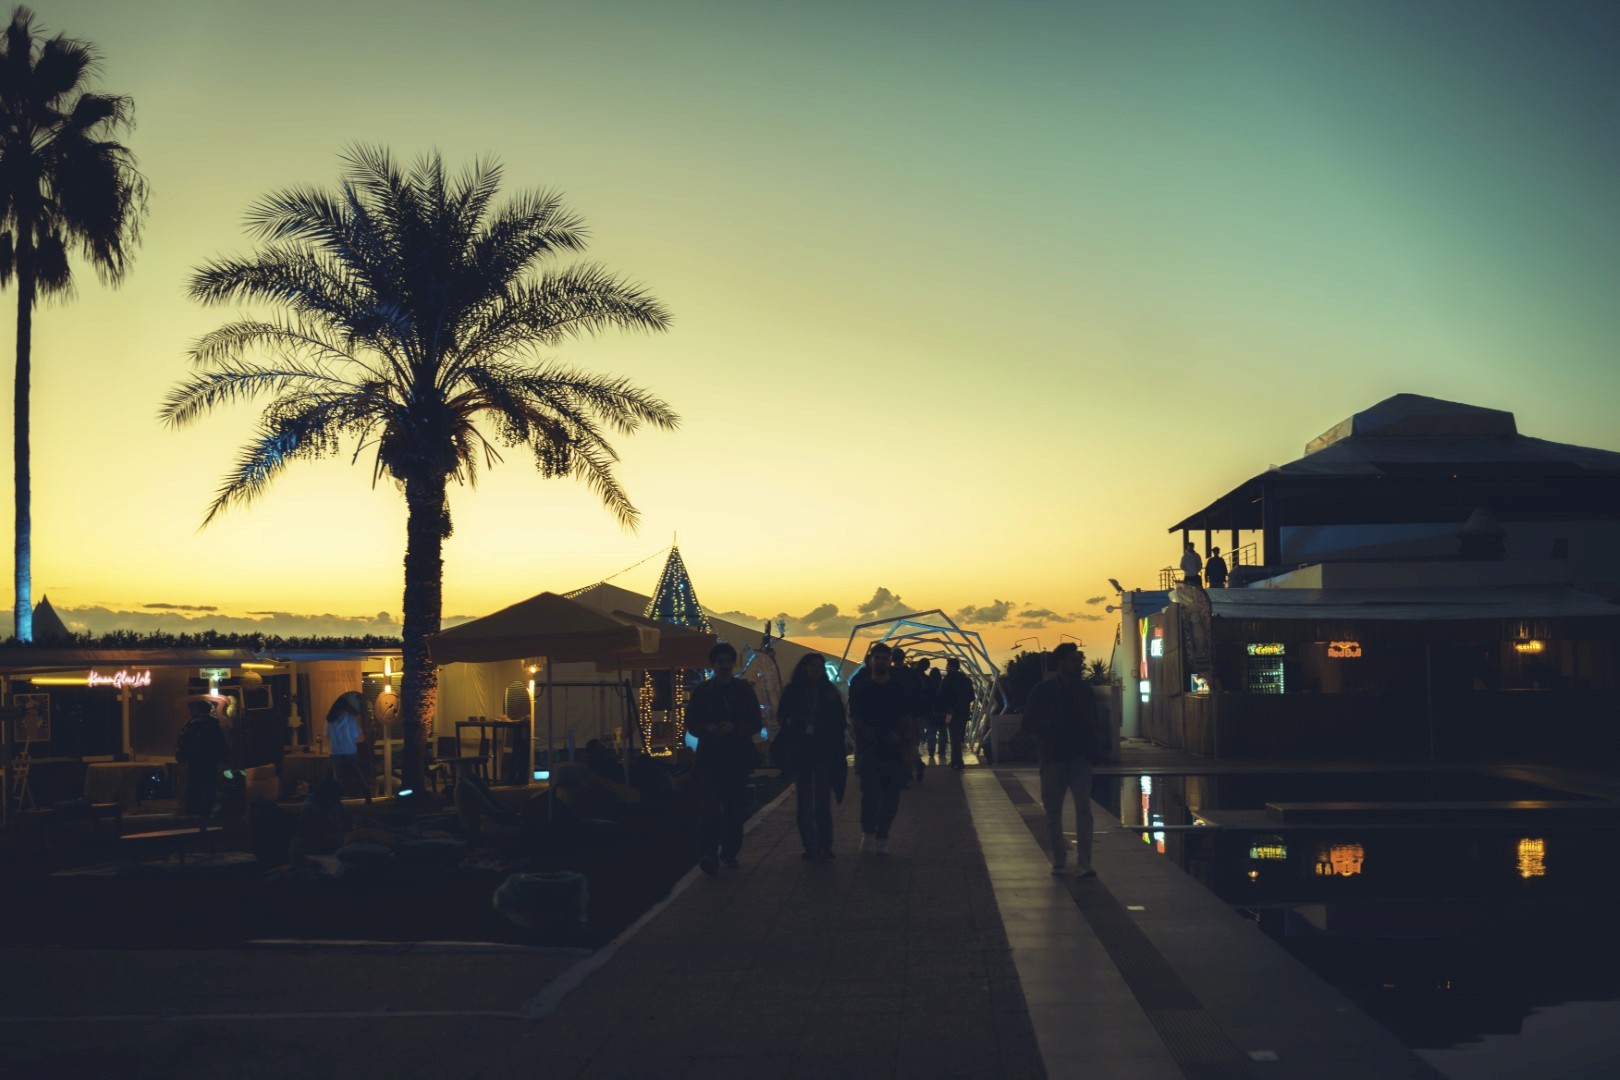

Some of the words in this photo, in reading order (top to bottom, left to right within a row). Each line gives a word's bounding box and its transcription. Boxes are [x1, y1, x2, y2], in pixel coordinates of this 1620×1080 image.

[1328, 648, 1344, 658] Red
[1345, 648, 1361, 658] Bull
[113, 669, 135, 688] Glow
[132, 669, 151, 687] Lab
